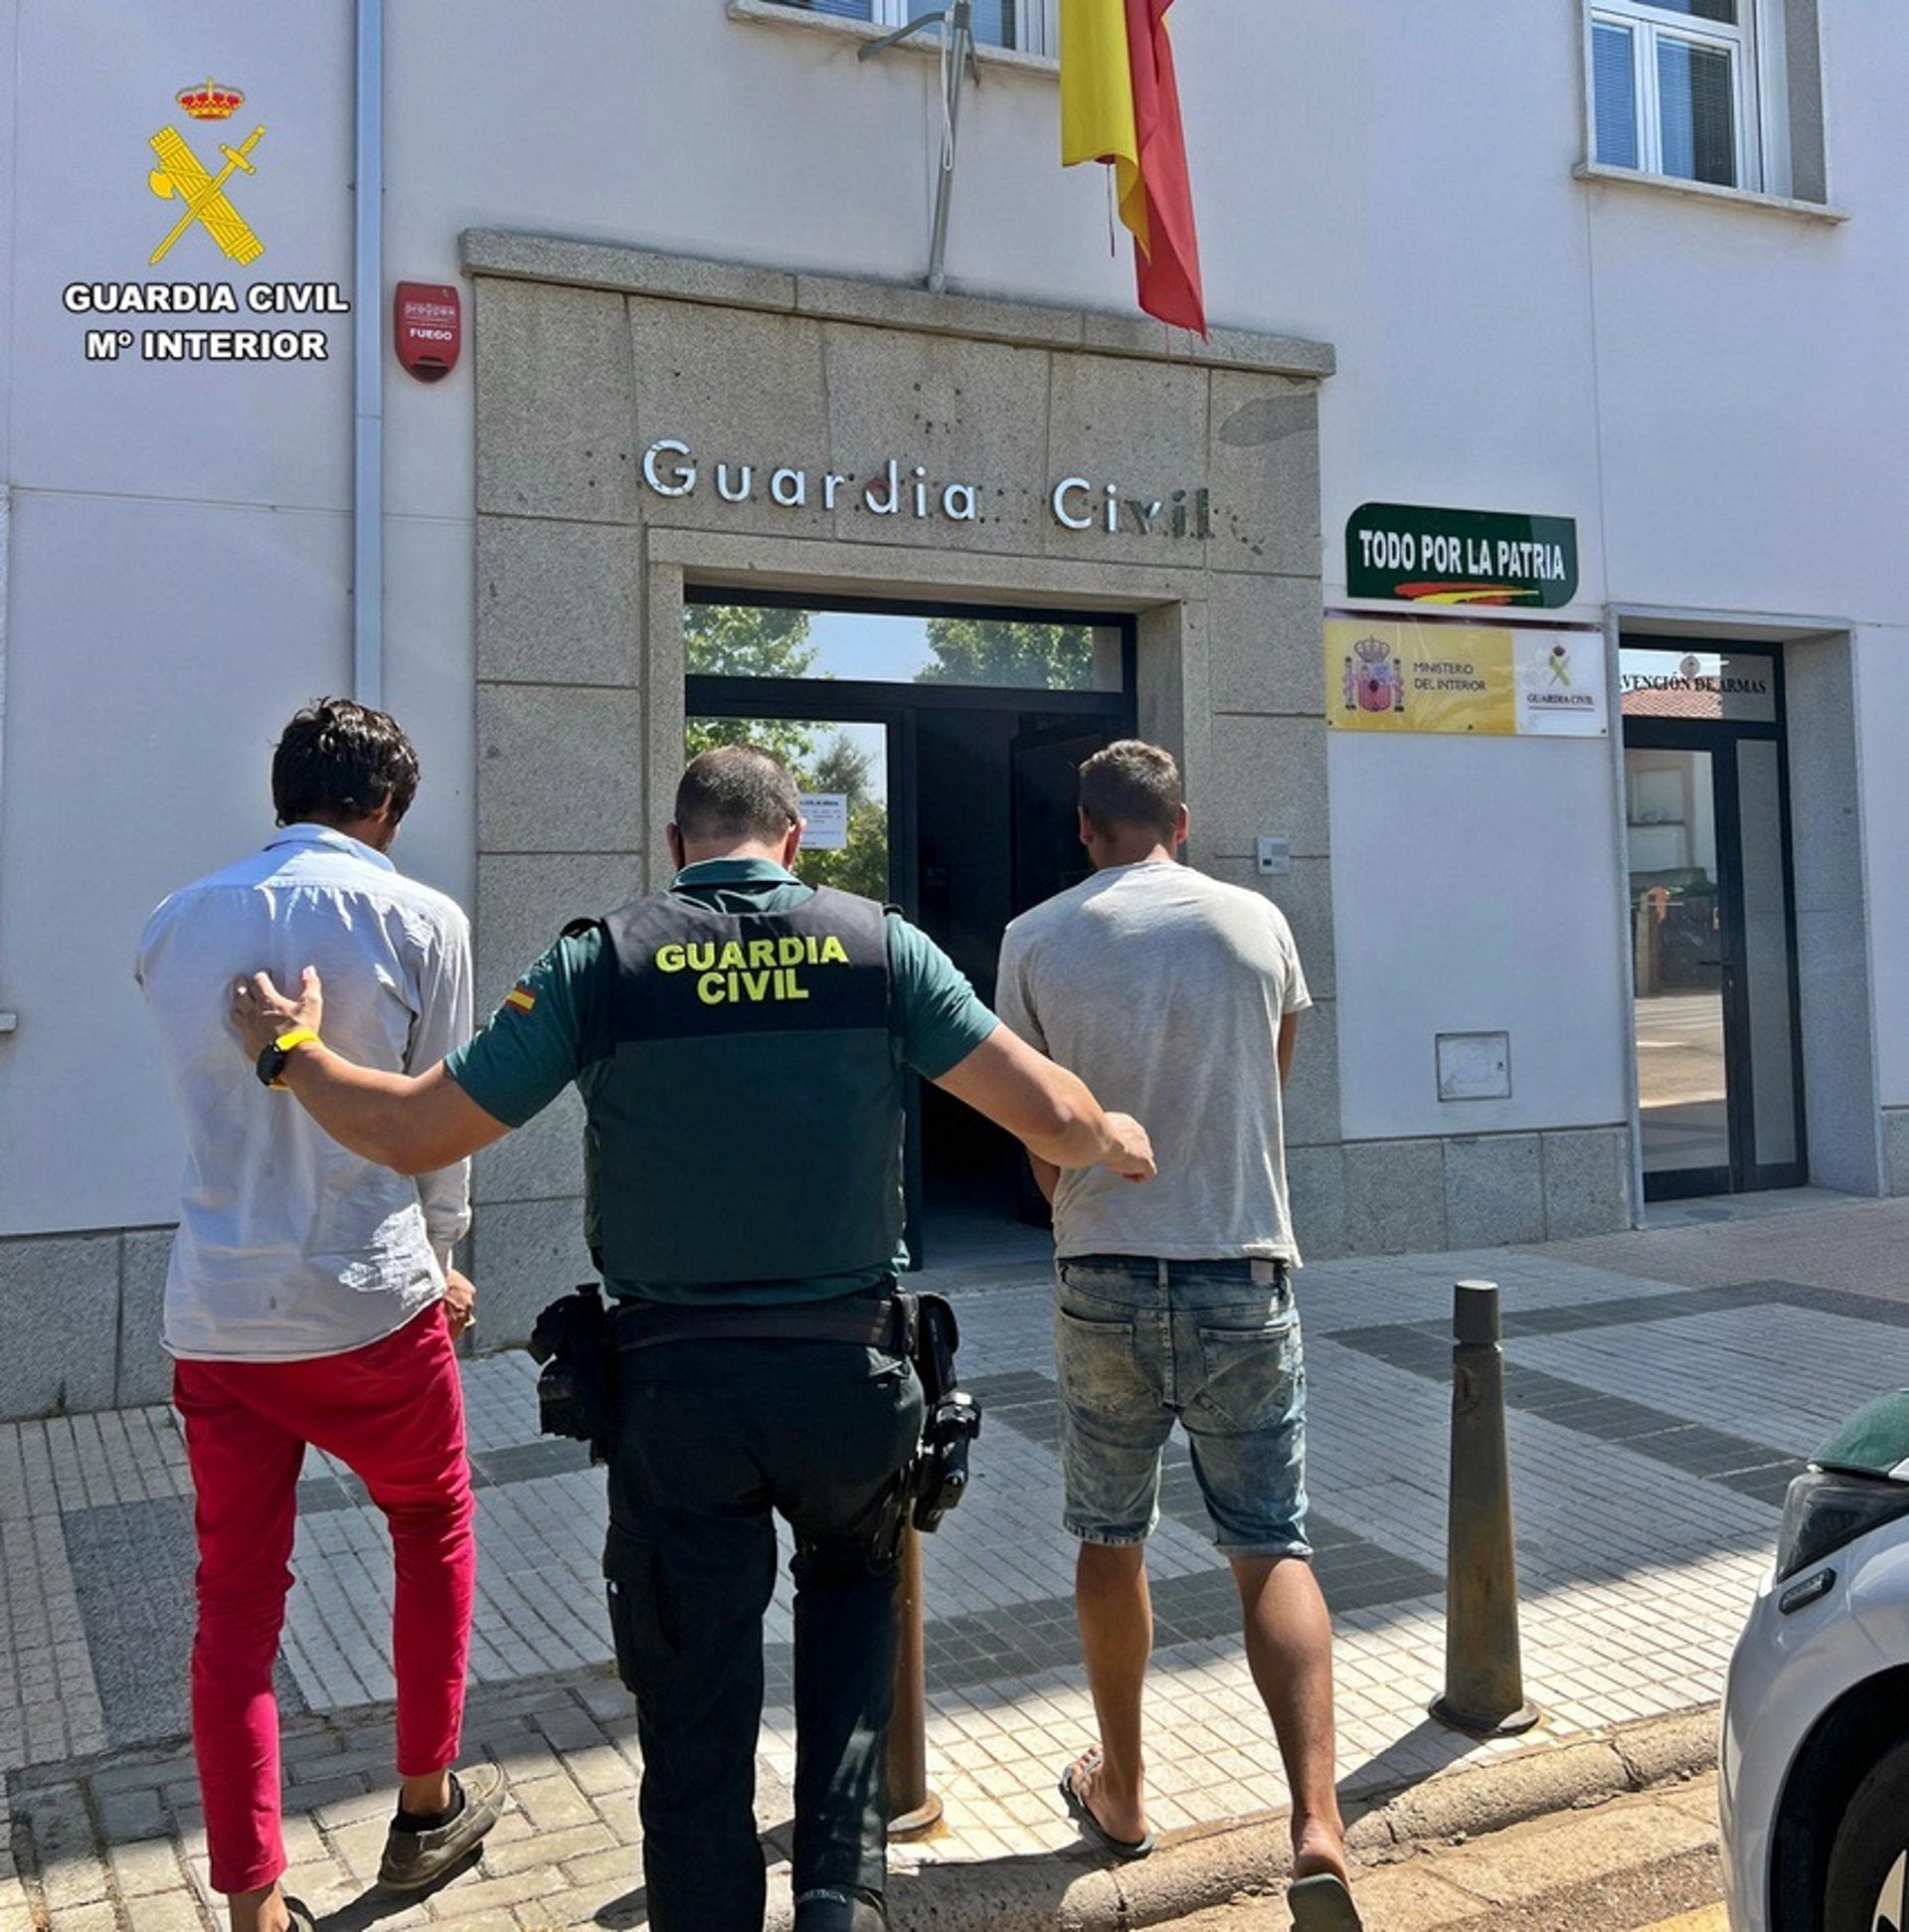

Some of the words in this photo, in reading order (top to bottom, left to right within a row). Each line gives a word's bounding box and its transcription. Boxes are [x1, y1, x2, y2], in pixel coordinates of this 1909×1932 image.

[410, 327, 452, 341] FUEGO
[643, 439, 977, 521] Guardia
[1051, 476, 1210, 540] Civil
[1358, 529, 1416, 571] TODO
[1421, 534, 1463, 574] POR
[1468, 538, 1492, 576] LA
[1497, 540, 1566, 581] PATRIA
[1414, 662, 1474, 675] MINISTERIO
[1414, 678, 1434, 690] DEL
[1438, 679, 1487, 693] INTERIOR
[1620, 671, 1691, 691] VENCIÓN
[1694, 677, 1715, 692] DE
[1717, 679, 1767, 694] ARMAS
[1527, 693, 1569, 704] GUARDIA
[1570, 695, 1595, 706] CIVIL
[655, 936, 849, 972] GUARDIA
[697, 968, 809, 1004] CIVIL
